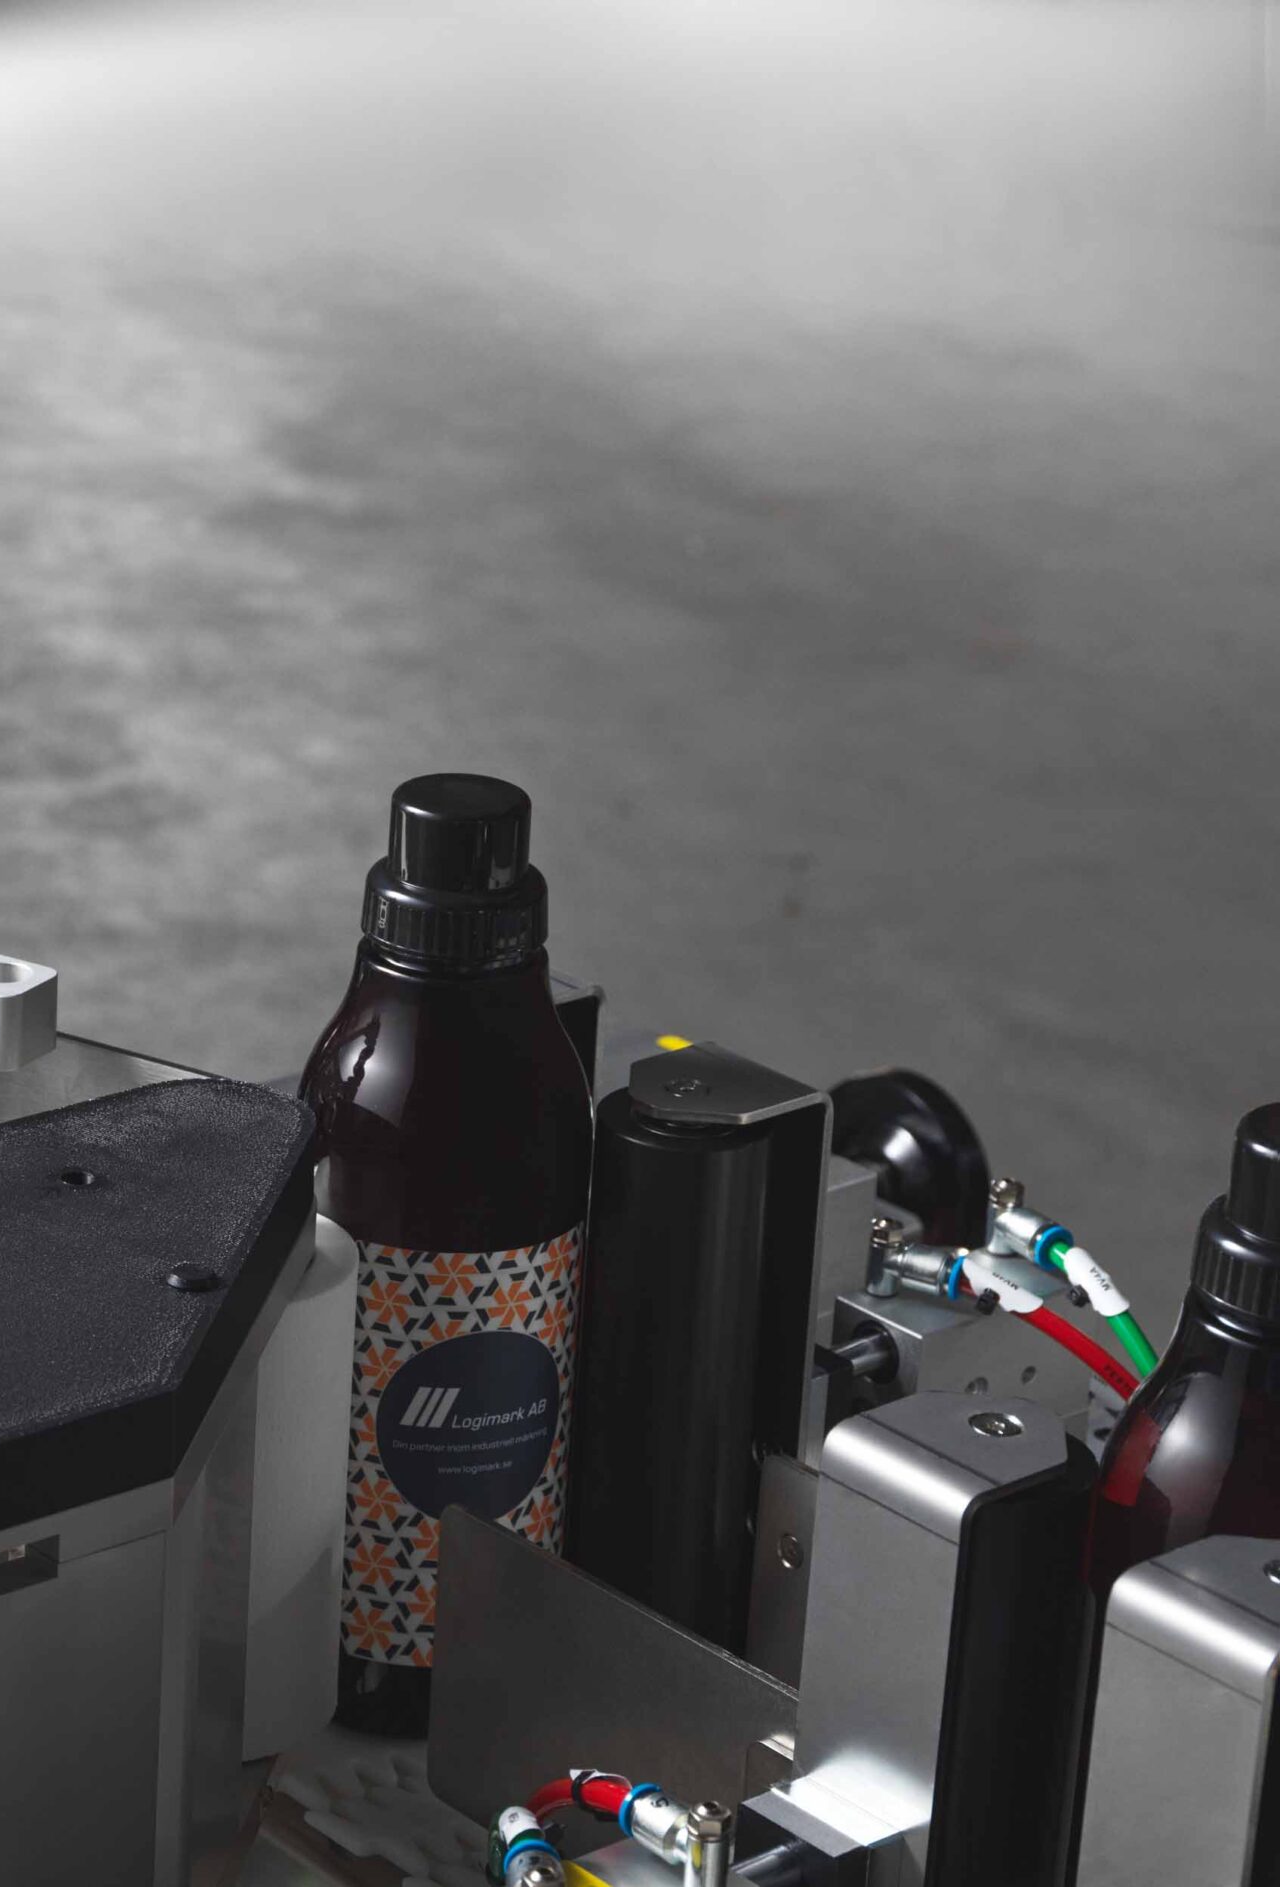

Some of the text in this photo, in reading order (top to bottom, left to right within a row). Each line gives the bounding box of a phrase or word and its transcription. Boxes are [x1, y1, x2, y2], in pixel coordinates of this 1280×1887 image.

[450, 1398, 548, 1432] Logimark AB
[392, 1439, 409, 1450] Din
[409, 1441, 446, 1453] partner
[446, 1442, 471, 1452] inom
[471, 1436, 515, 1450] industriell
[437, 1460, 514, 1475] www.logimark.se
